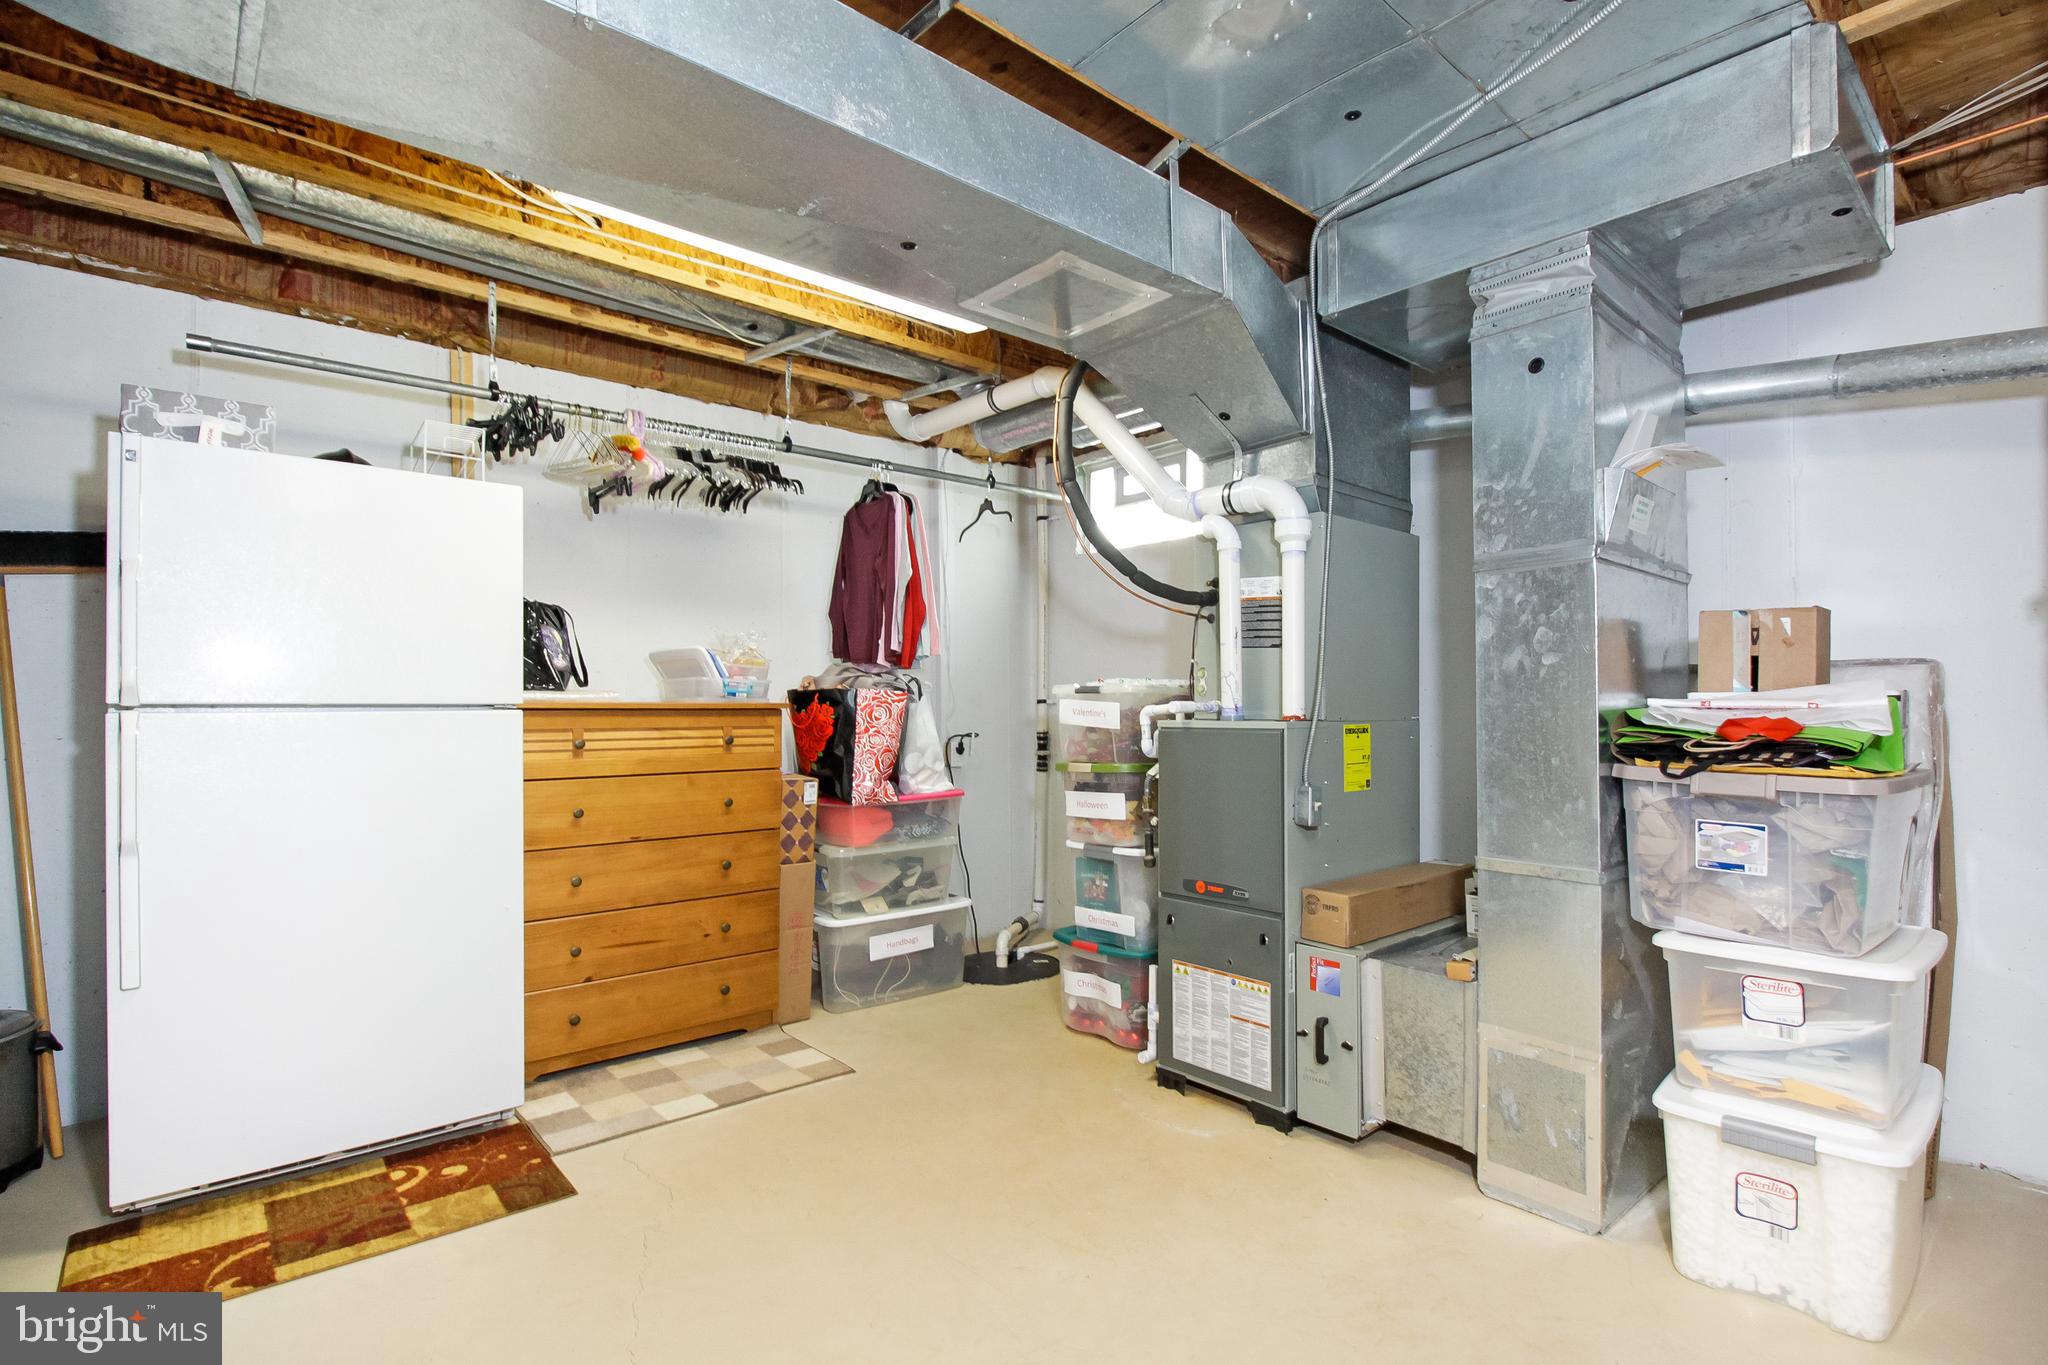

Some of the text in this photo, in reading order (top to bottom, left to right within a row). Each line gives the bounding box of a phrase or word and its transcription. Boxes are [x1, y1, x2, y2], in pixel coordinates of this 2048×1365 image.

[1072, 707, 1106, 718] Valentine's
[1076, 800, 1109, 809] Halloween
[1088, 913, 1119, 928] Christmas
[886, 935, 919, 949] Handbags
[1748, 979, 1795, 994] Sterilite
[1743, 1176, 1790, 1196] Sterilite
